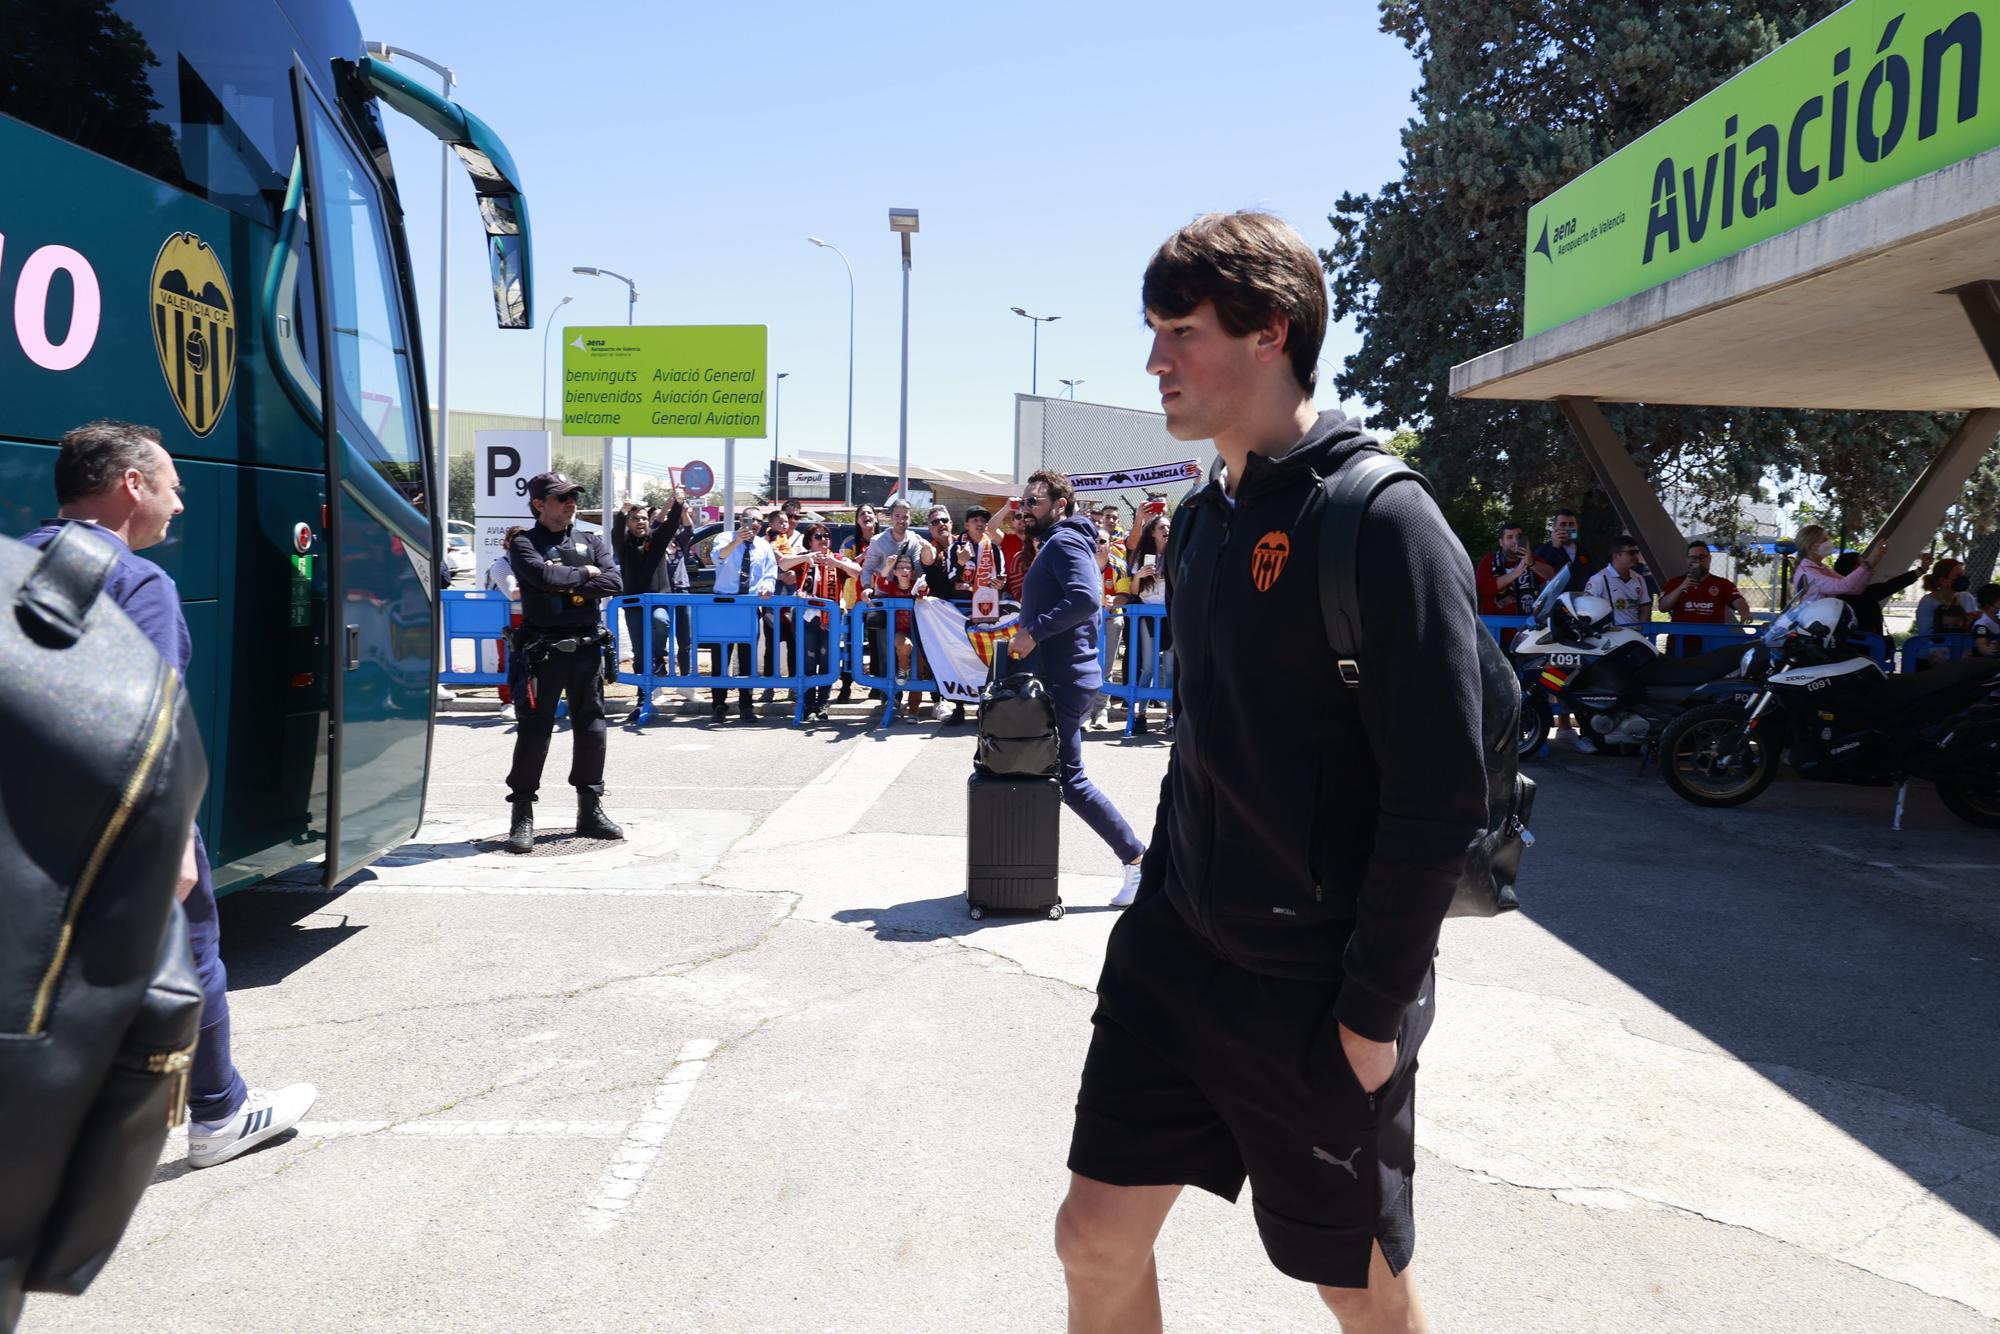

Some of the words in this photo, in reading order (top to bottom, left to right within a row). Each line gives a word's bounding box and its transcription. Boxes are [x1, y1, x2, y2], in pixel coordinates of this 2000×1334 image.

[1642, 12, 1983, 265] Aviación
[1553, 217, 1577, 243] aena
[1558, 233, 1589, 256] Aeropuerto
[1590, 227, 1598, 240] de
[1599, 211, 1625, 234] Valencia
[160, 291, 210, 318] VALENCIA
[214, 310, 231, 325] C.F.
[566, 369, 637, 385] benvinguts
[652, 369, 701, 382] Aviació
[704, 368, 756, 382] General
[565, 390, 643, 403] bienvenidos
[652, 390, 708, 403] Aviación
[712, 390, 764, 403] General
[565, 411, 621, 424] welcome
[651, 412, 702, 425] General
[705, 412, 760, 425] Aviation
[1133, 467, 1180, 482] VALÈNCIA
[1071, 477, 1103, 487] AMUNT
[1557, 654, 1581, 665] 091
[1813, 678, 1832, 691] 091
